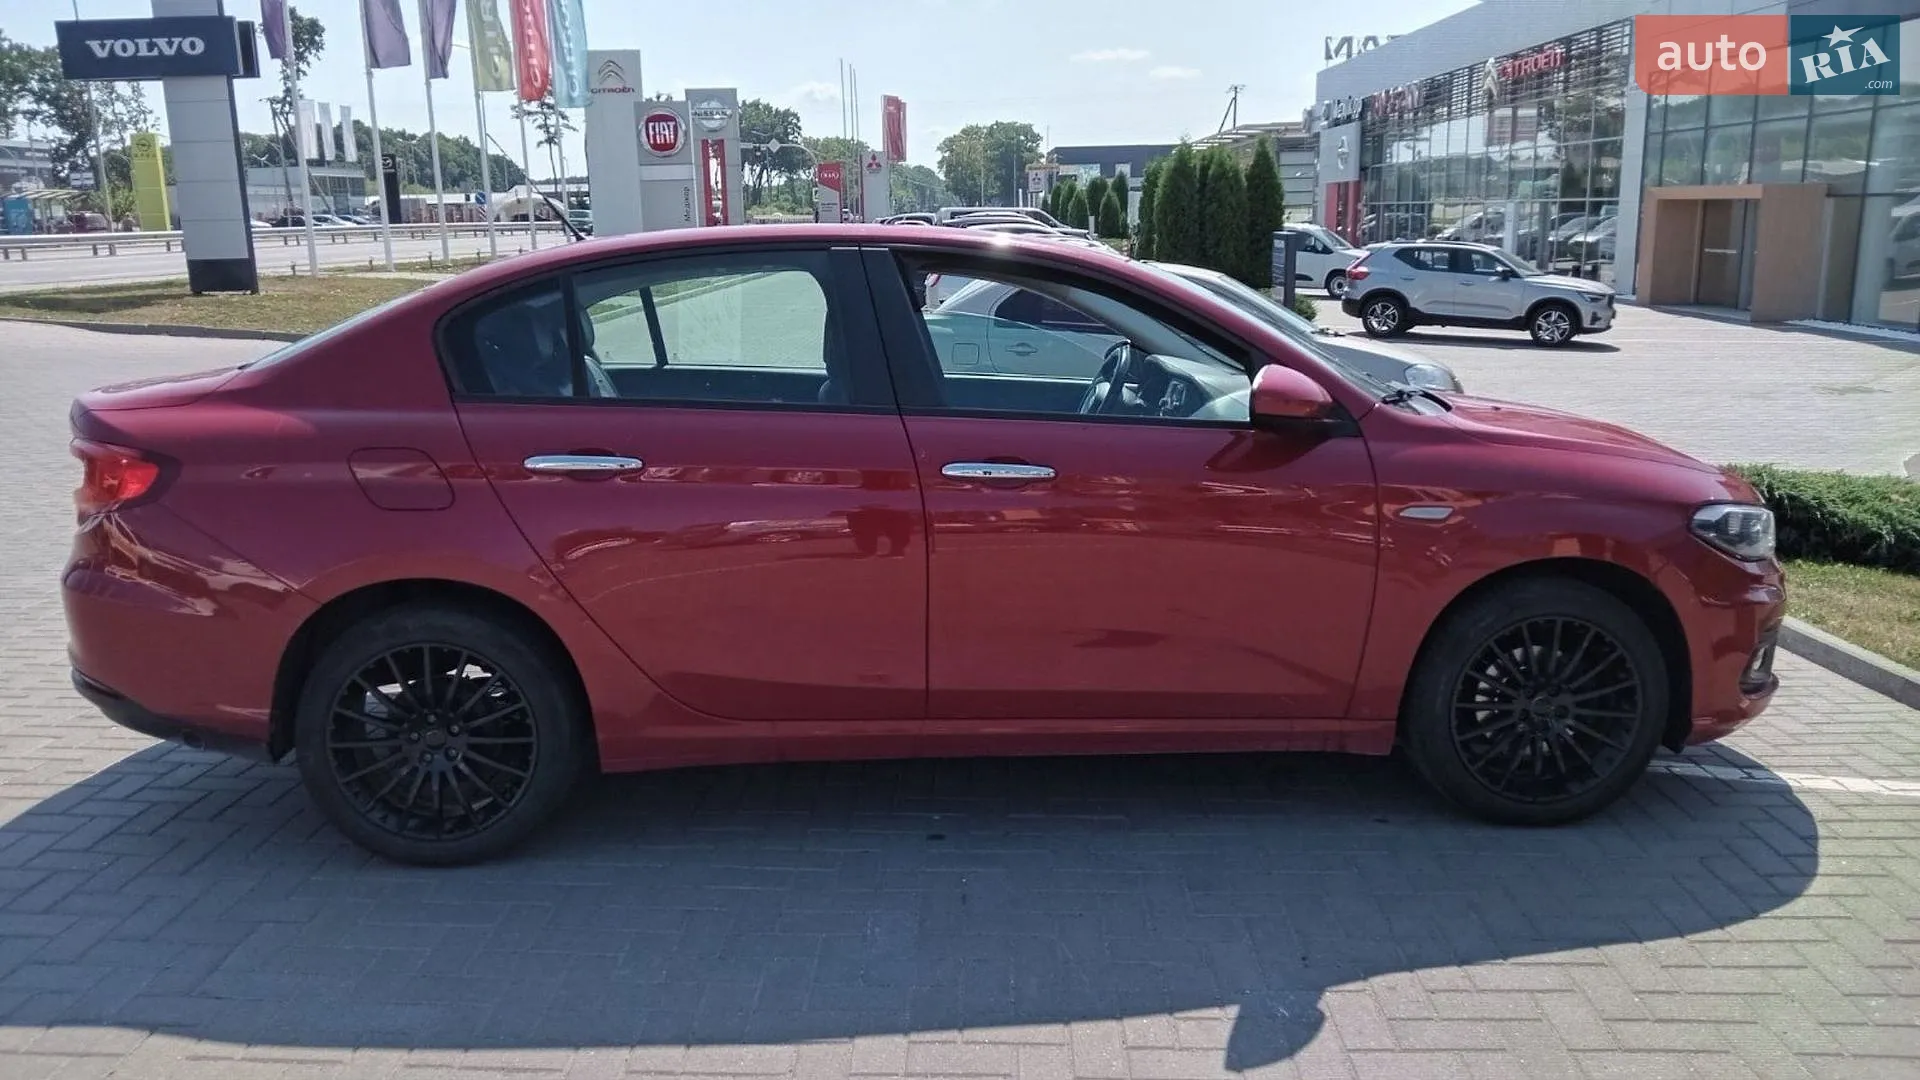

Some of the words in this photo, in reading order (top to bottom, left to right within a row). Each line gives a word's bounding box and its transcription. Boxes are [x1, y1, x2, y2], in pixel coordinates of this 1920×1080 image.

[86, 37, 206, 59] VOLVO
[694, 110, 728, 118] NISSAN
[648, 120, 676, 145] FIAT
